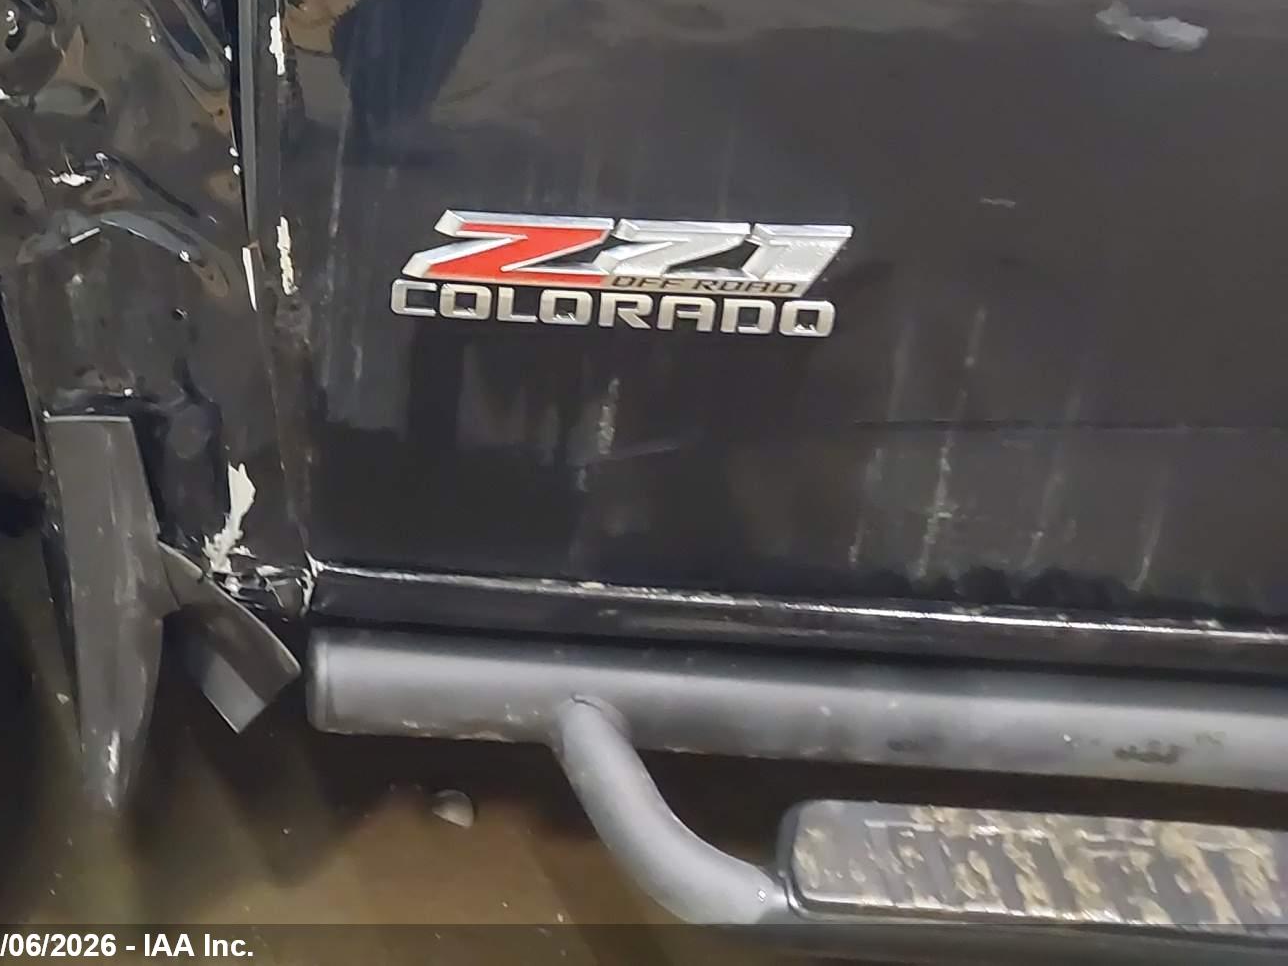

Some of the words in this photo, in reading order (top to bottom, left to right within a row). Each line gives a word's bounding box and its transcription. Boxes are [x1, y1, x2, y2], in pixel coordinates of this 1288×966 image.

[402, 209, 854, 297] Z71
[390, 278, 837, 338] COLORADO
[611, 275, 685, 290] OFF
[692, 278, 798, 295] ROAD
